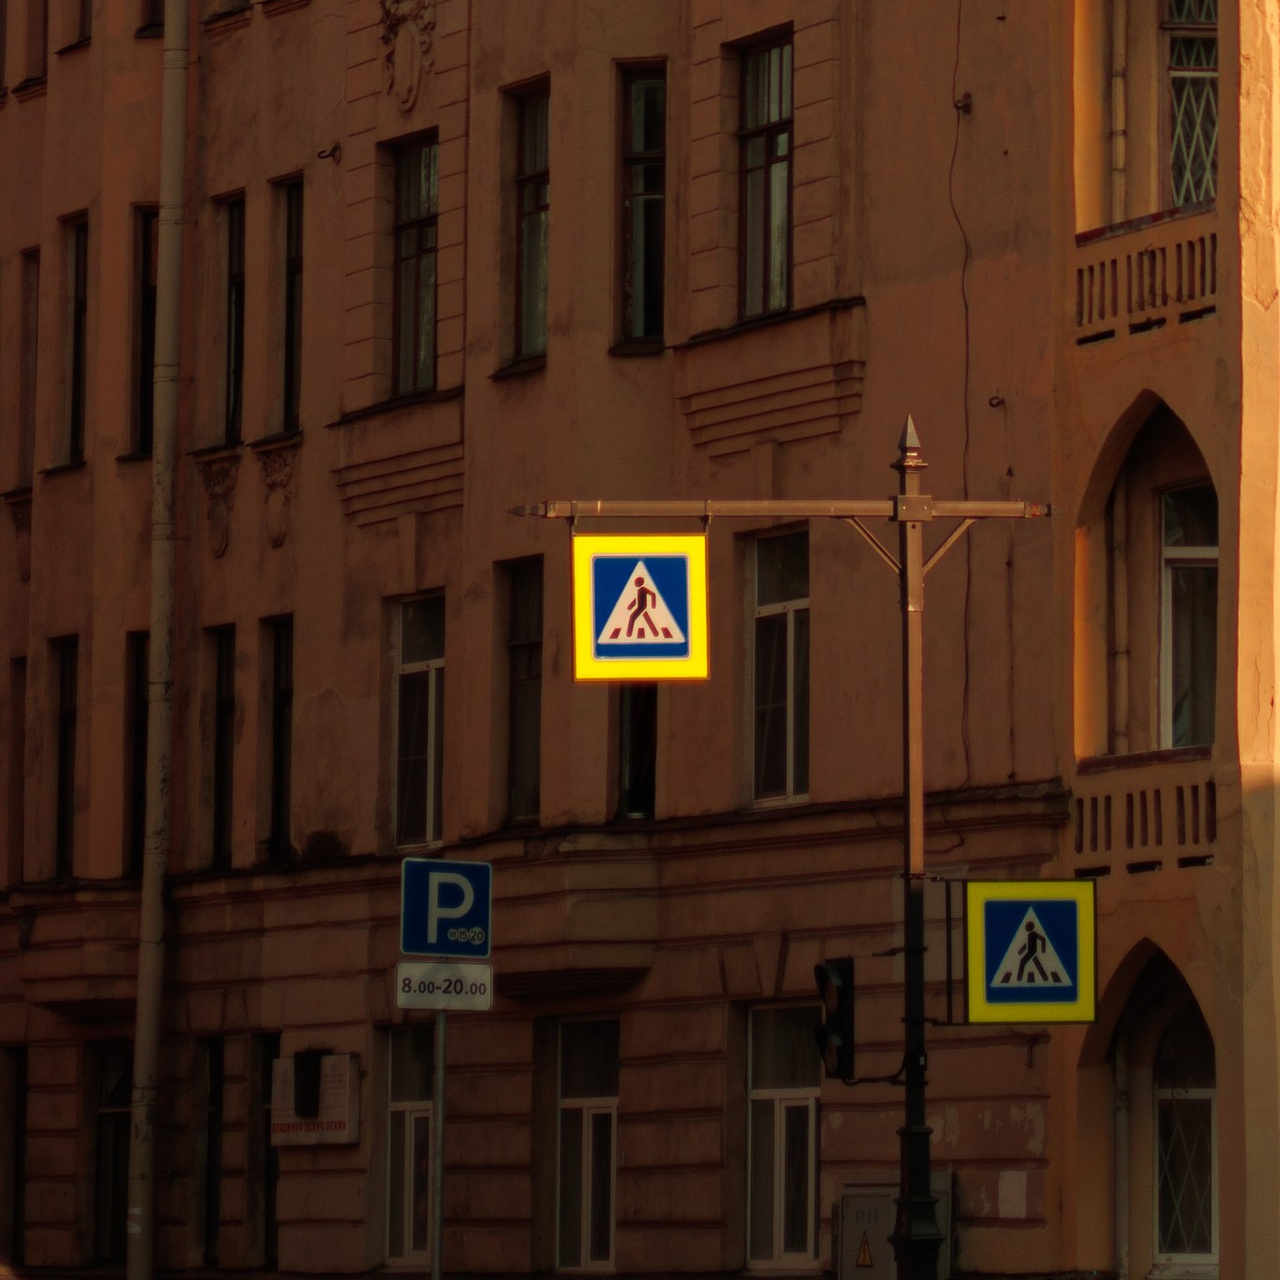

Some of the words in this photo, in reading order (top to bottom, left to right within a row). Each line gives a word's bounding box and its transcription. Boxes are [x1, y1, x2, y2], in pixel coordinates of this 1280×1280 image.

[427, 871, 474, 944] P
[458, 930, 468, 939] 15
[470, 931, 484, 941] 20
[401, 977, 487, 995] 8.00-20.00
